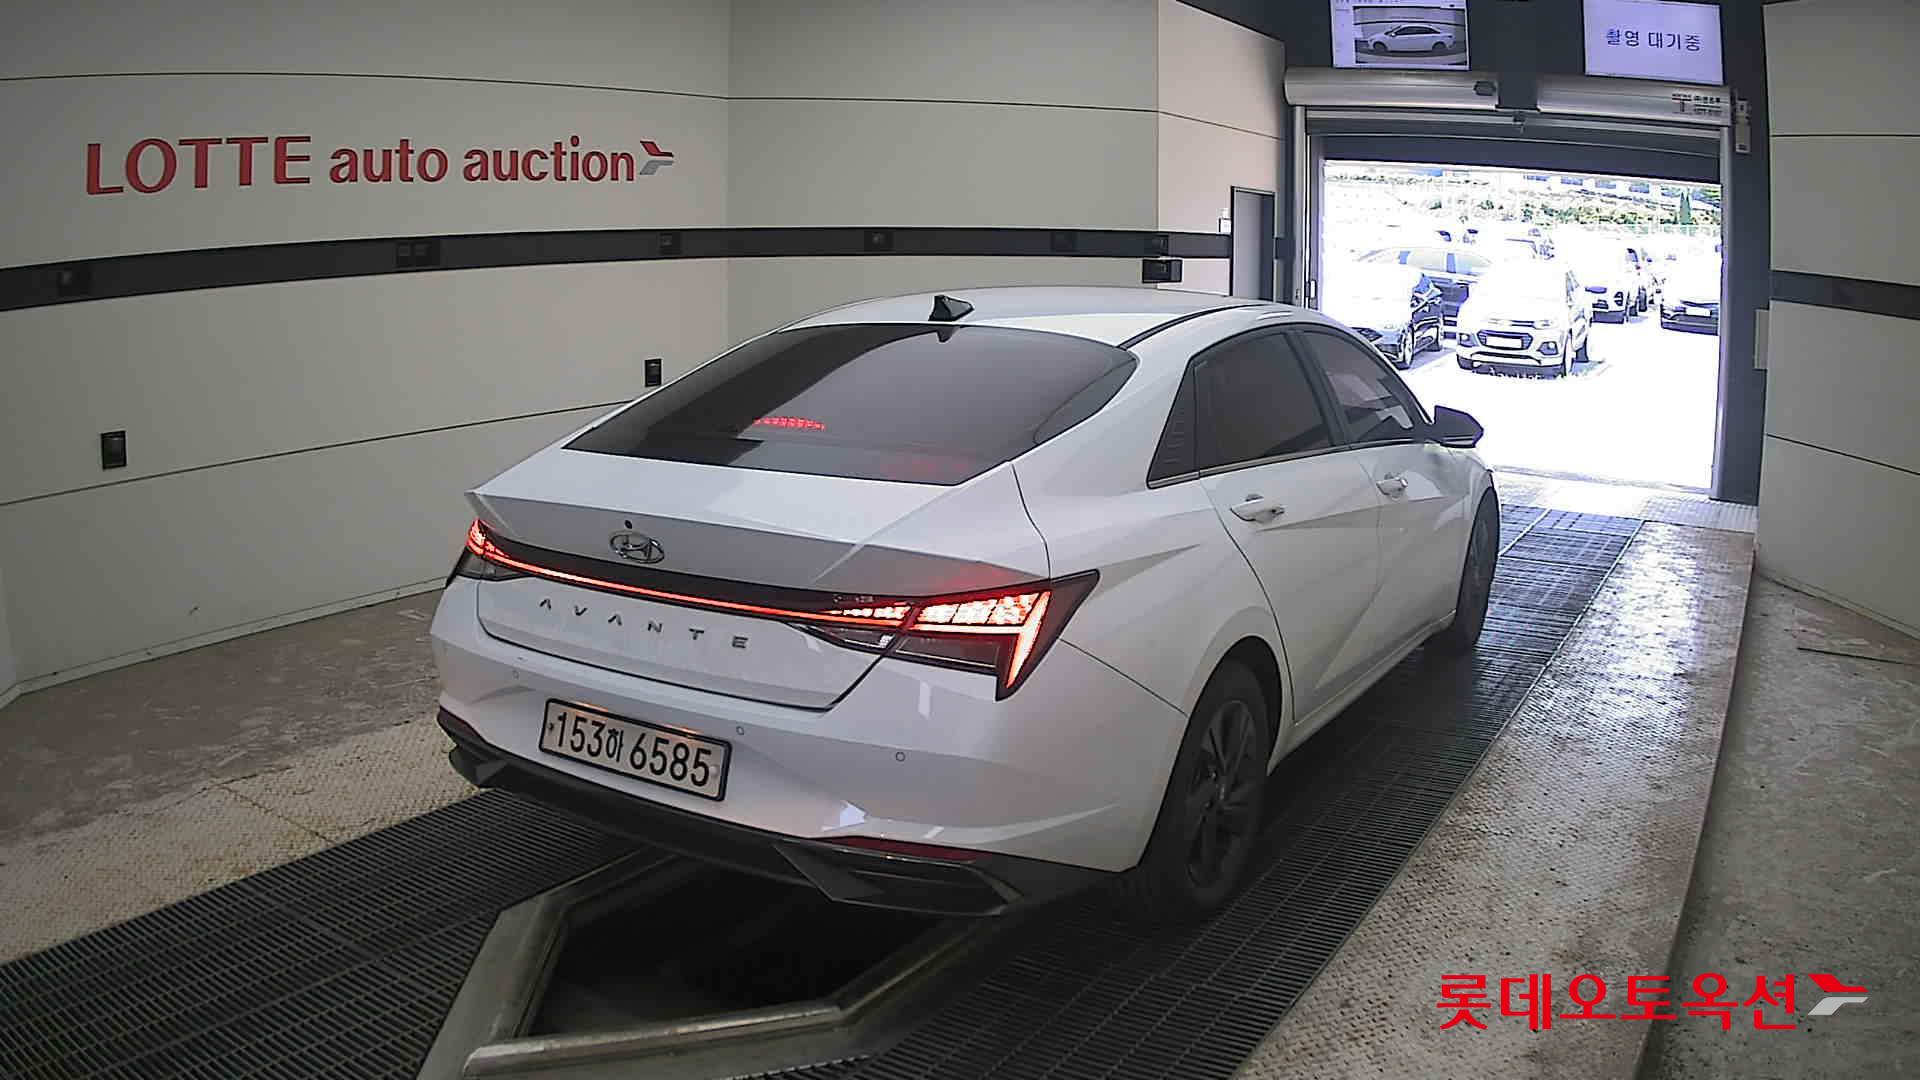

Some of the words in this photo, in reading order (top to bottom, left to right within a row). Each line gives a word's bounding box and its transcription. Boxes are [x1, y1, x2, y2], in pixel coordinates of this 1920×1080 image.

[1647, 31, 1701, 52] 대기중
[86, 136, 311, 195] LOTTE
[329, 139, 448, 184] auto
[463, 135, 635, 183] auction
[539, 598, 749, 649] AVANTE
[557, 711, 625, 762] 153하
[630, 732, 712, 787] 6585
